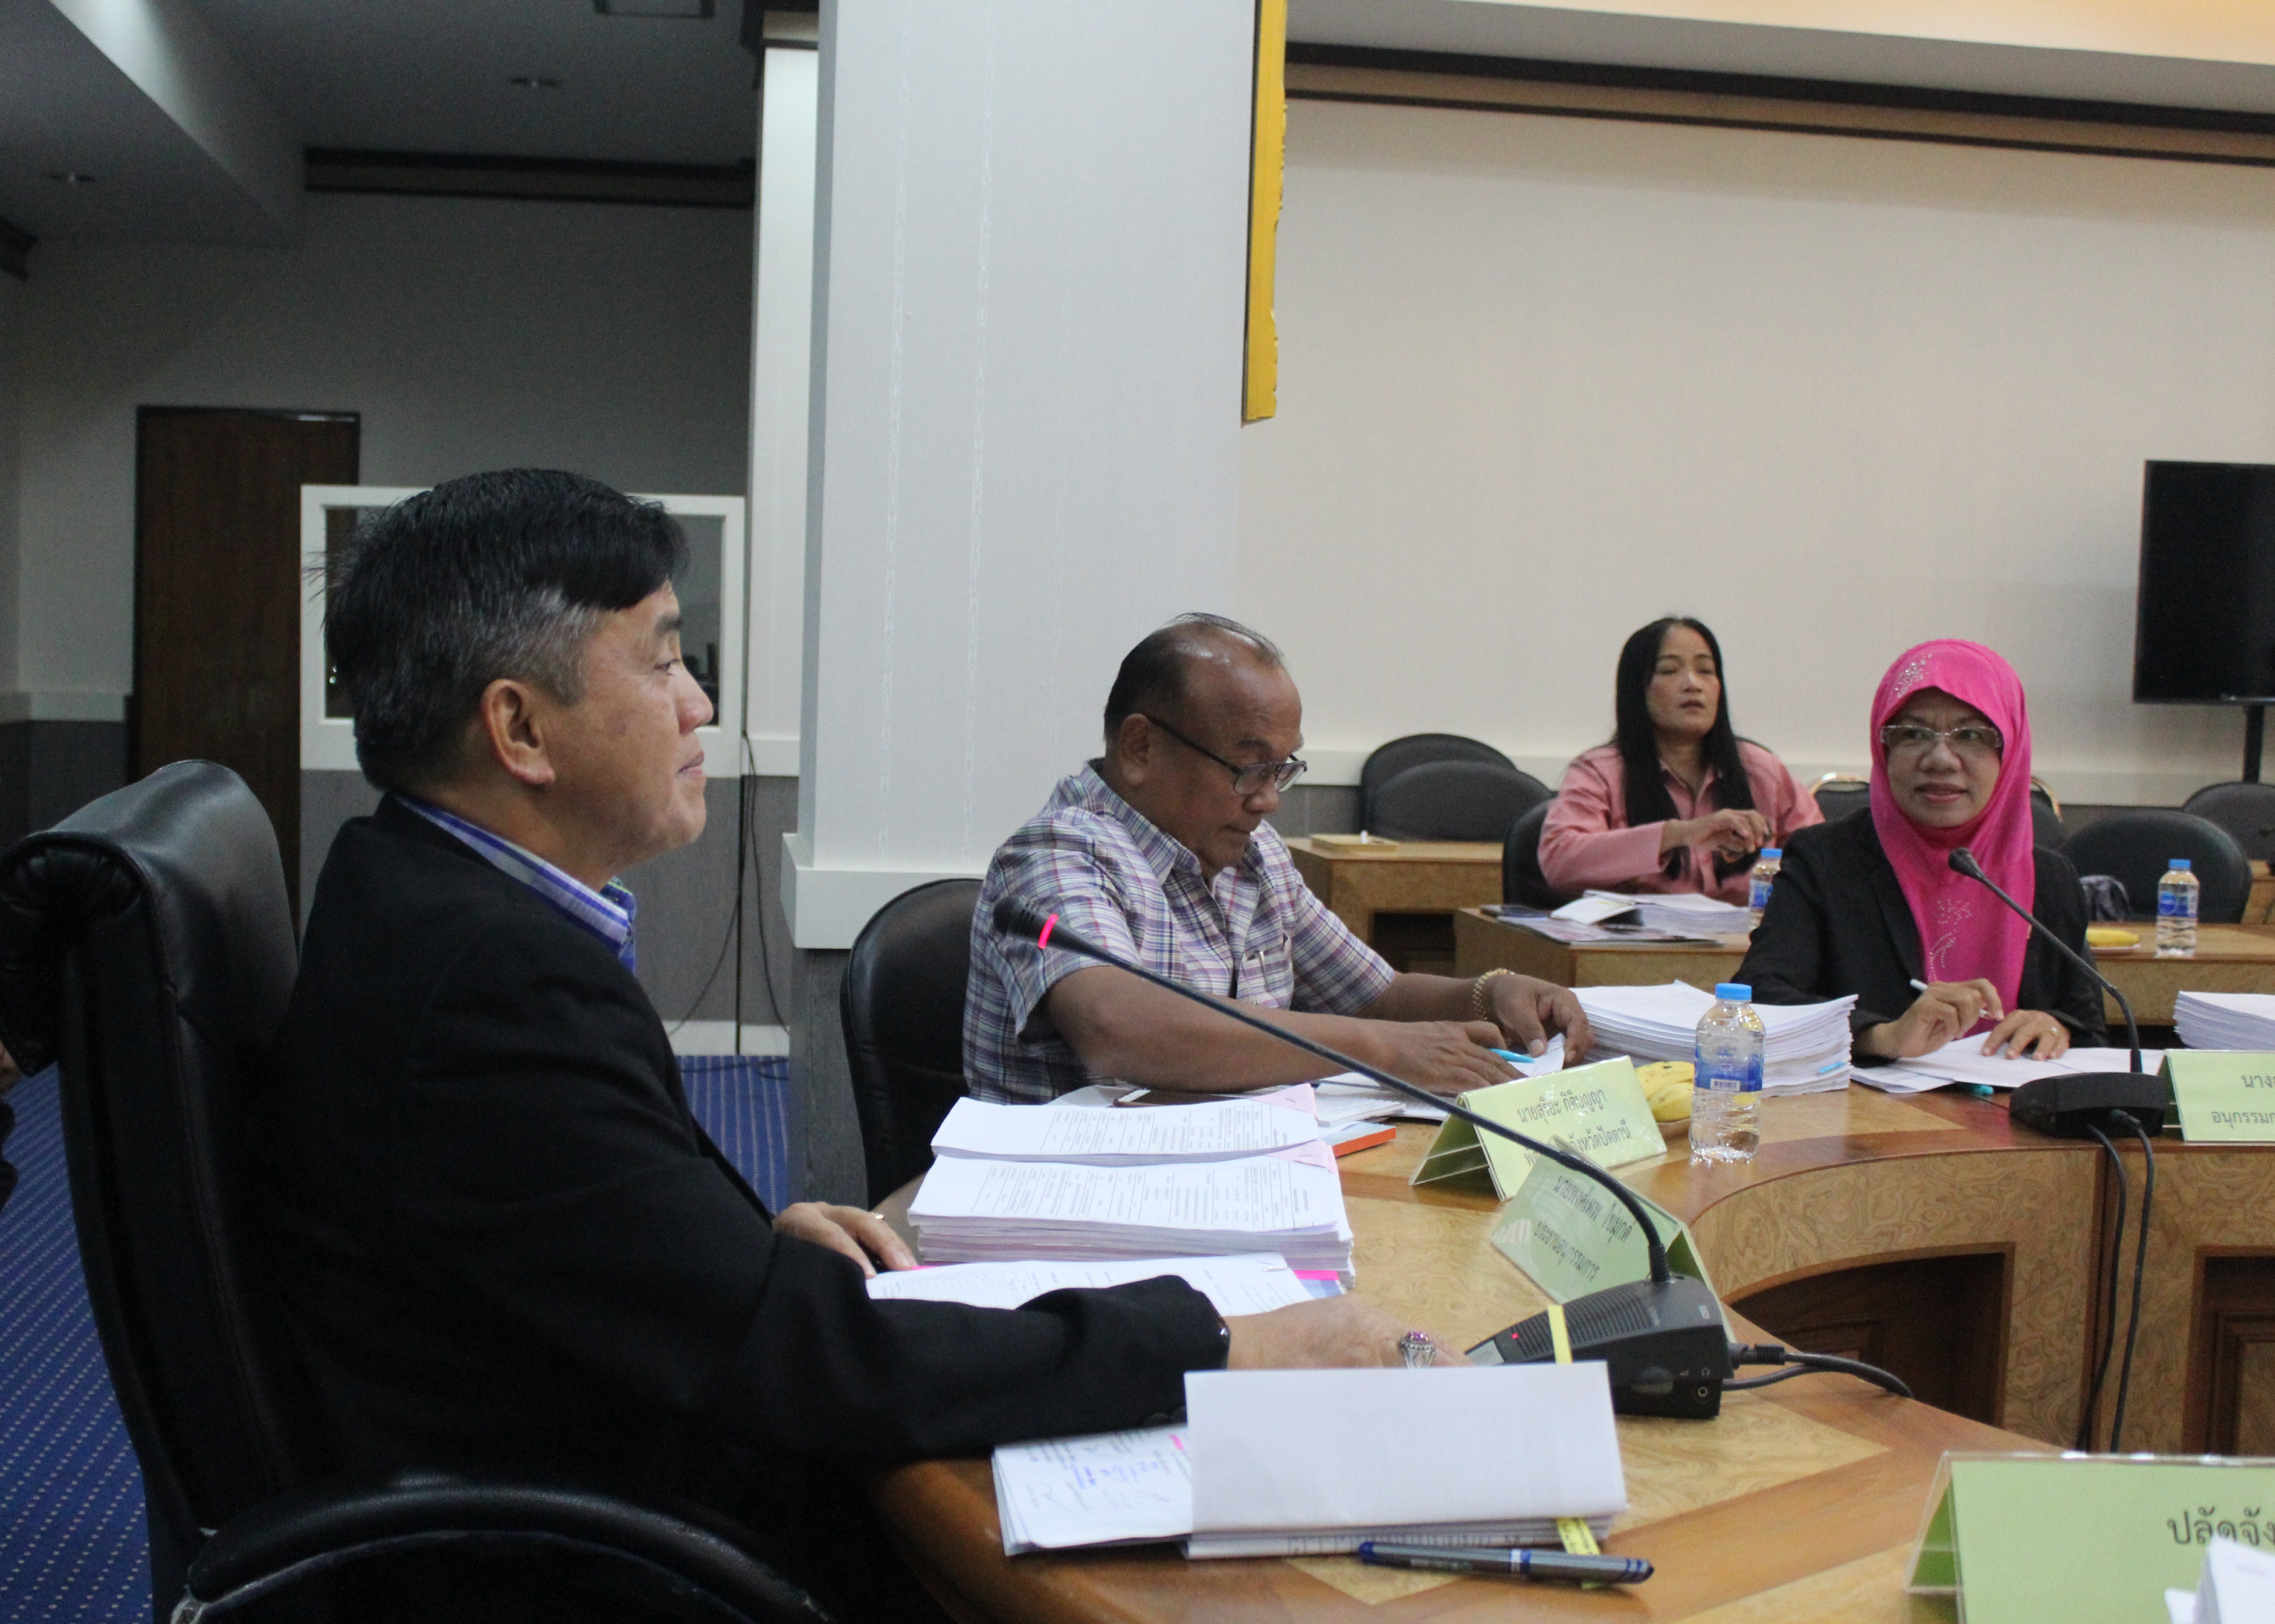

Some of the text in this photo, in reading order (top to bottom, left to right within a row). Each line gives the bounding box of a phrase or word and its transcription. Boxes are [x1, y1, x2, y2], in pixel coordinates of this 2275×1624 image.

[2241, 1074, 2275, 1088] นาง
[1517, 1096, 1562, 1125] นายสุริยะ
